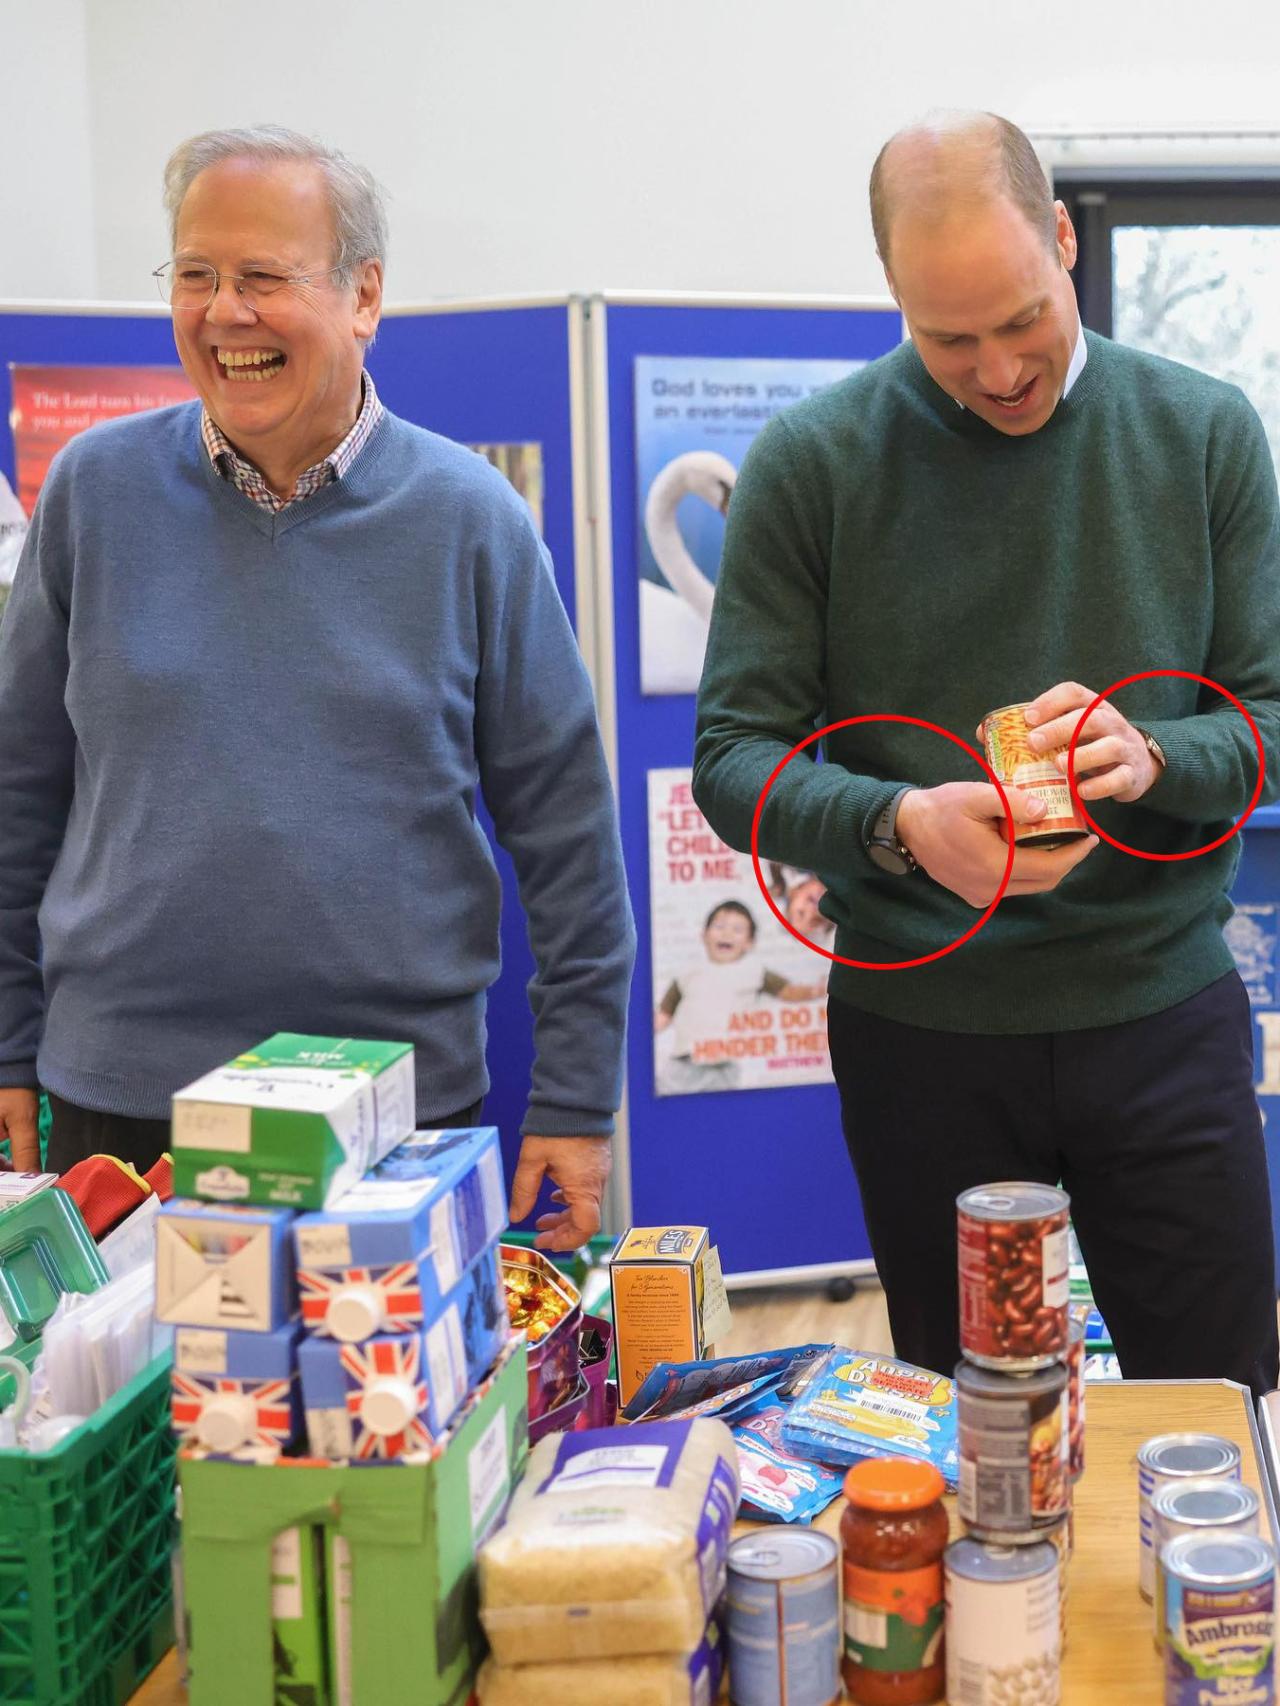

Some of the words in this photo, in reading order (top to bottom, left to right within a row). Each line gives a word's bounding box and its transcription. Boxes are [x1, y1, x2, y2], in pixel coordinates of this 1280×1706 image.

[652, 379, 694, 397] God
[703, 379, 757, 397] loves
[667, 863, 694, 882] TO
[728, 1011, 773, 1030] AND
[781, 1008, 811, 1028] DO
